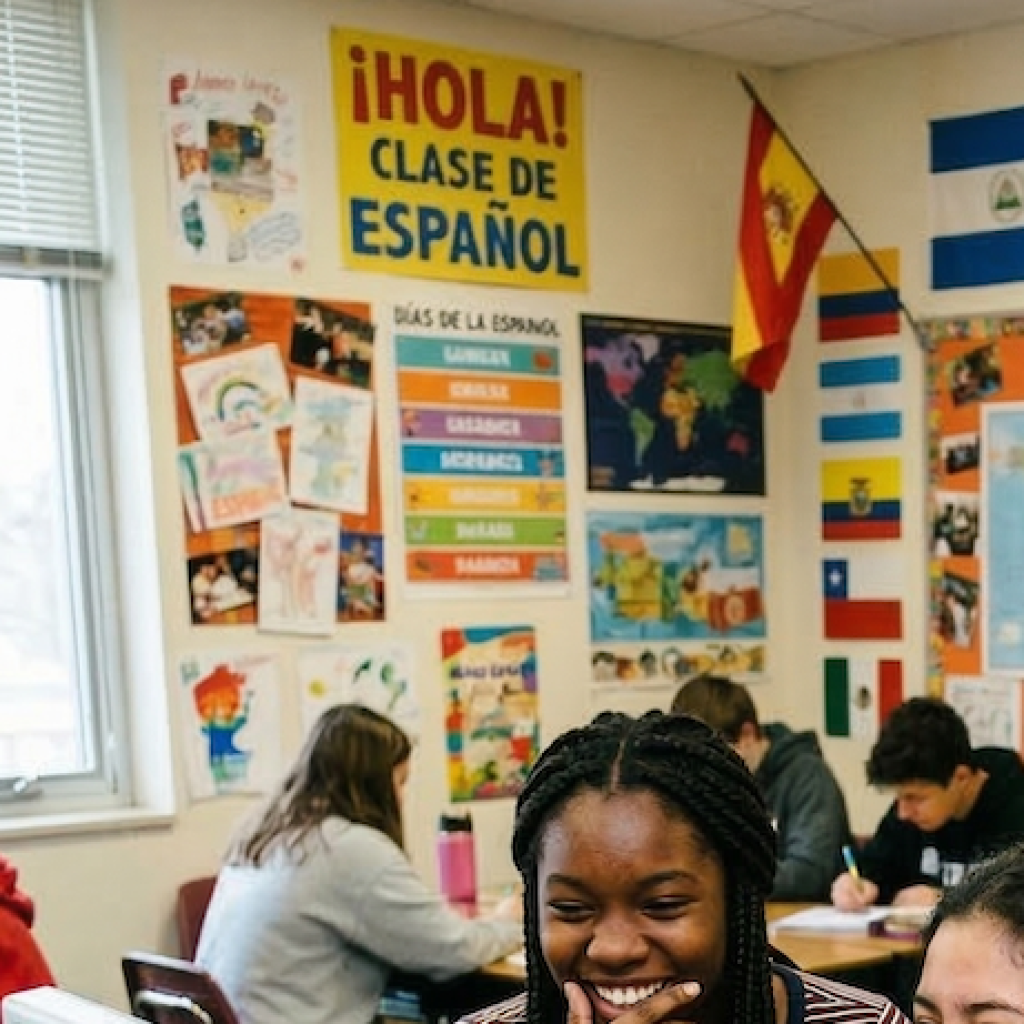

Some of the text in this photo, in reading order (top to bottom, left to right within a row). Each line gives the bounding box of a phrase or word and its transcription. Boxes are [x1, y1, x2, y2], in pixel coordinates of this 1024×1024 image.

[349, 45, 568, 148] ¡HOLA!
[370, 137, 557, 200] CLASE DE
[350, 198, 581, 278] ESPAÑOL
[439, 309, 462, 330] DE
[467, 313, 486, 331] LA
